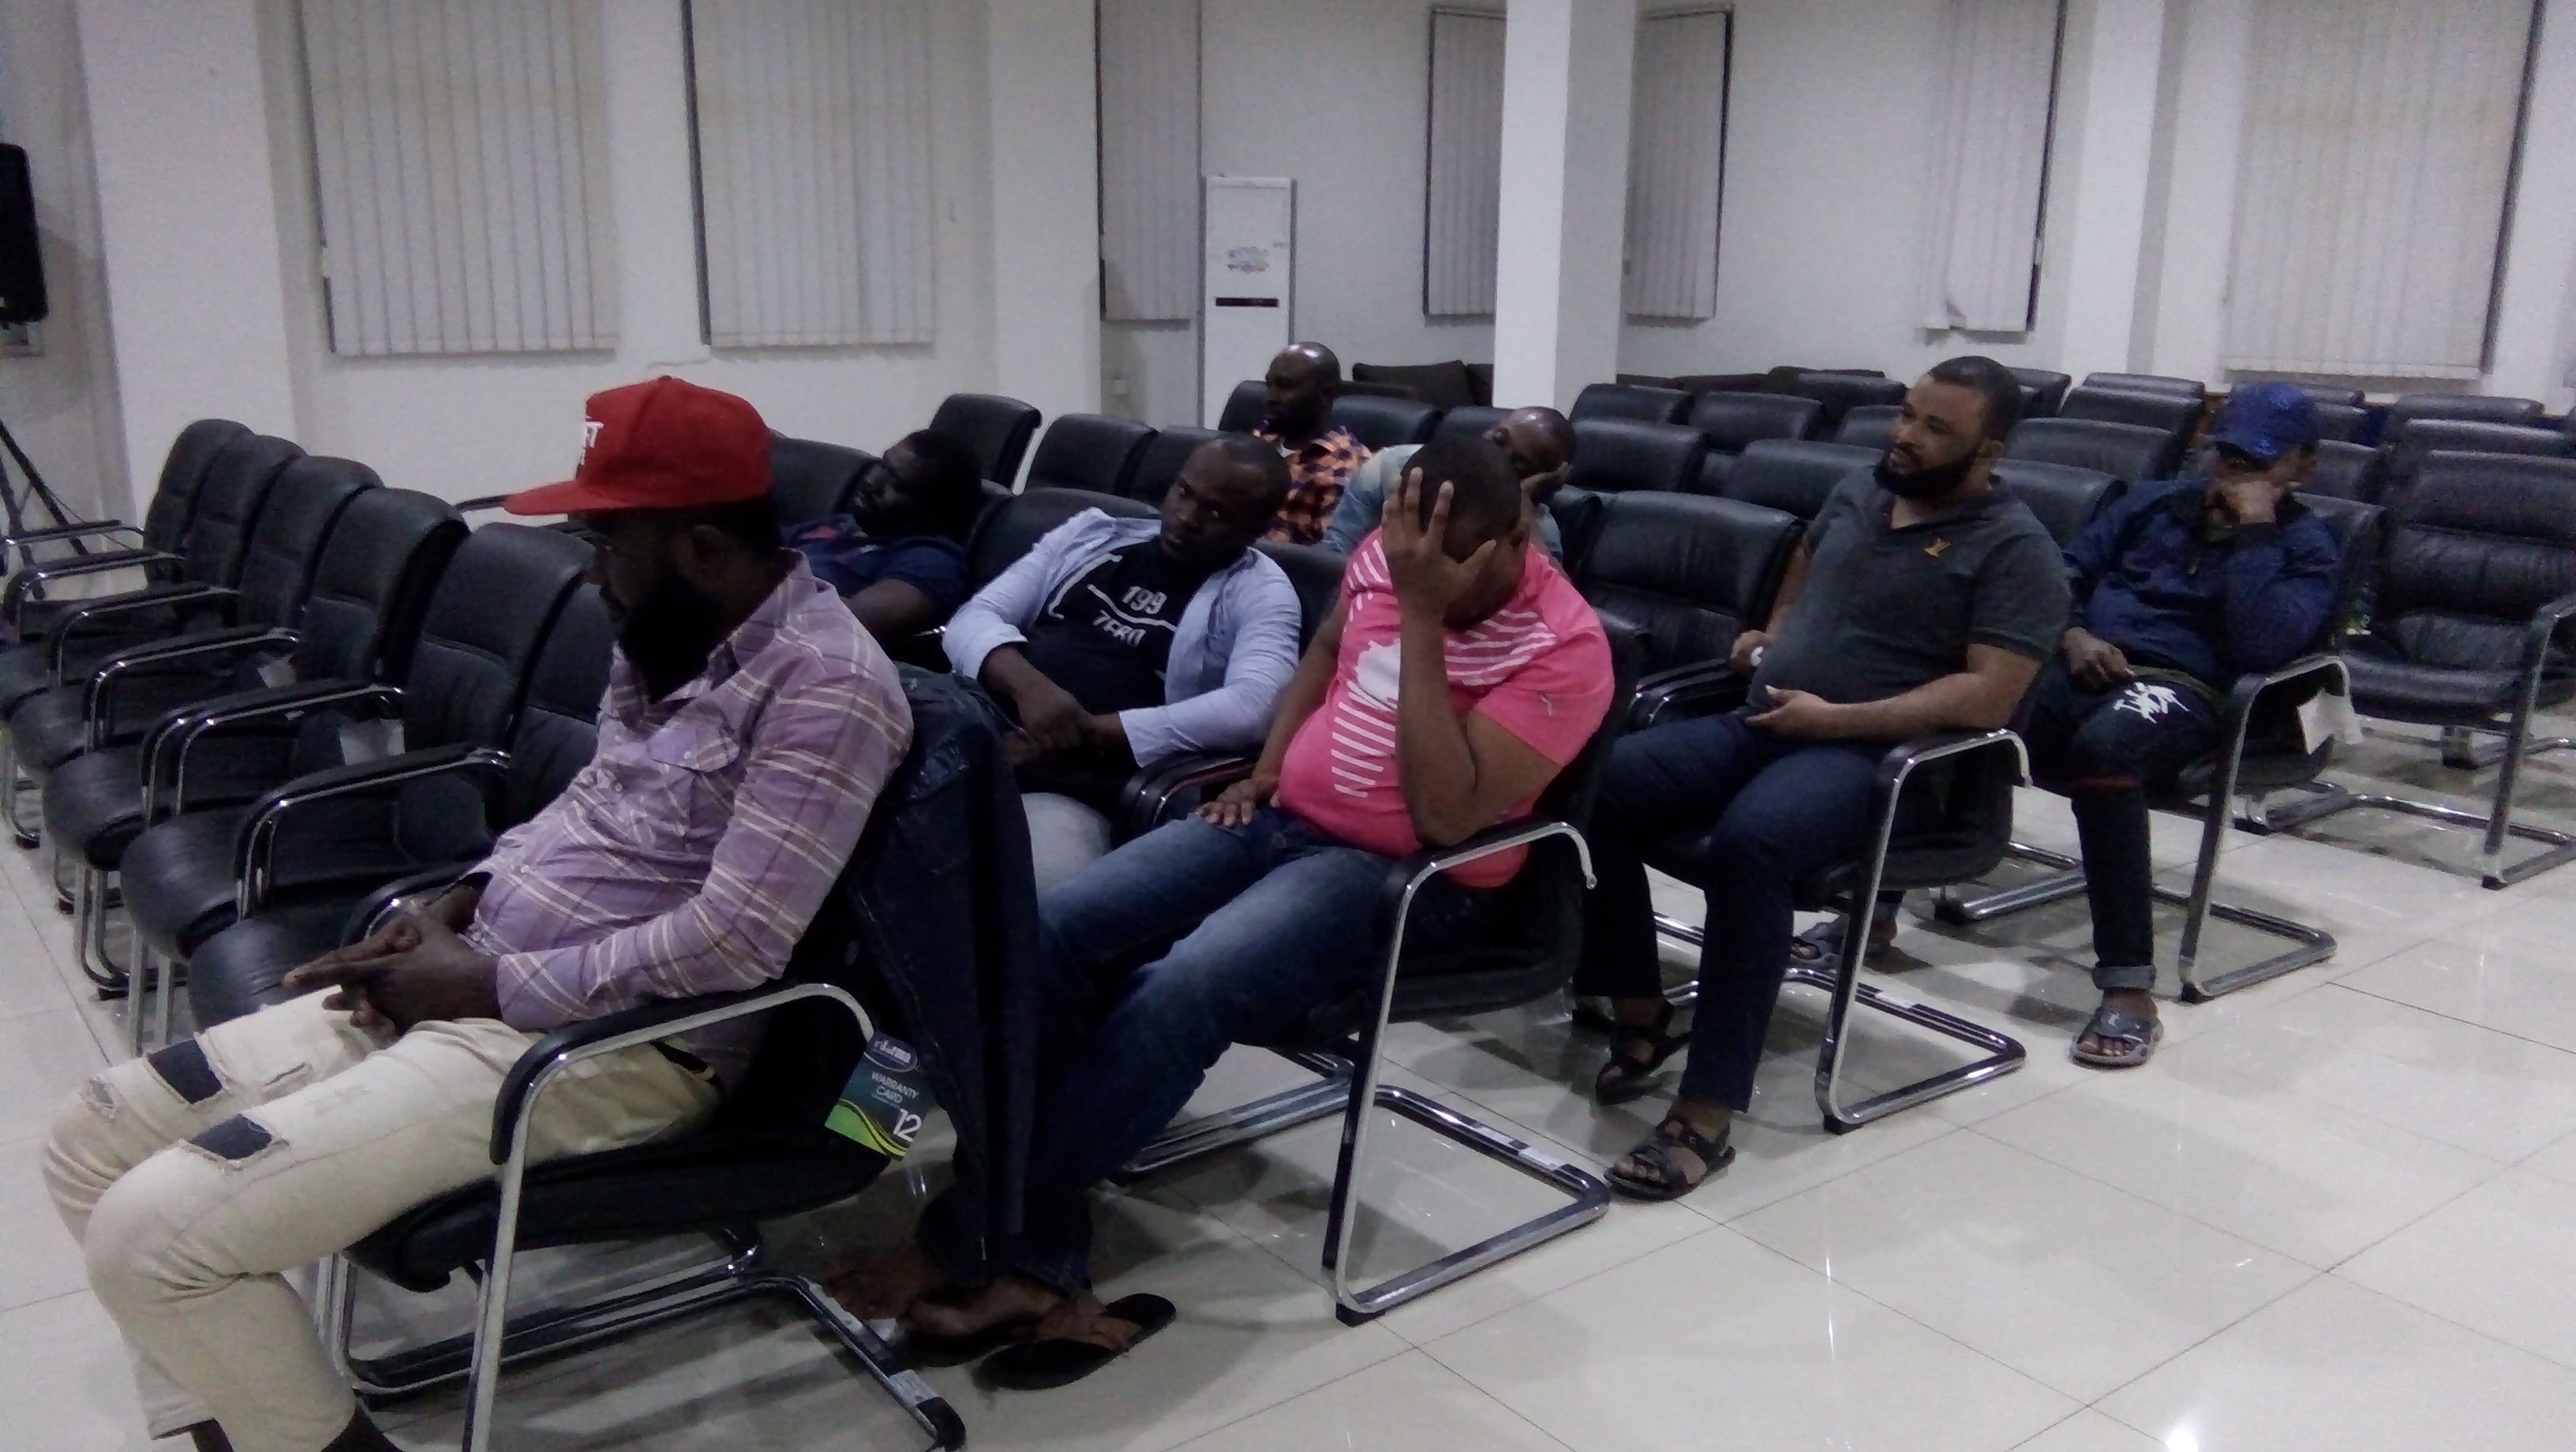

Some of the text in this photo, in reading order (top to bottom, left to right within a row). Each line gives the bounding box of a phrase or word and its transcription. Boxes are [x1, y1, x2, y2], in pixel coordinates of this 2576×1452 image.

[871, 1071, 919, 1100] WARRANTY
[875, 1085, 904, 1104] CARD
[893, 1107, 923, 1143] 12
